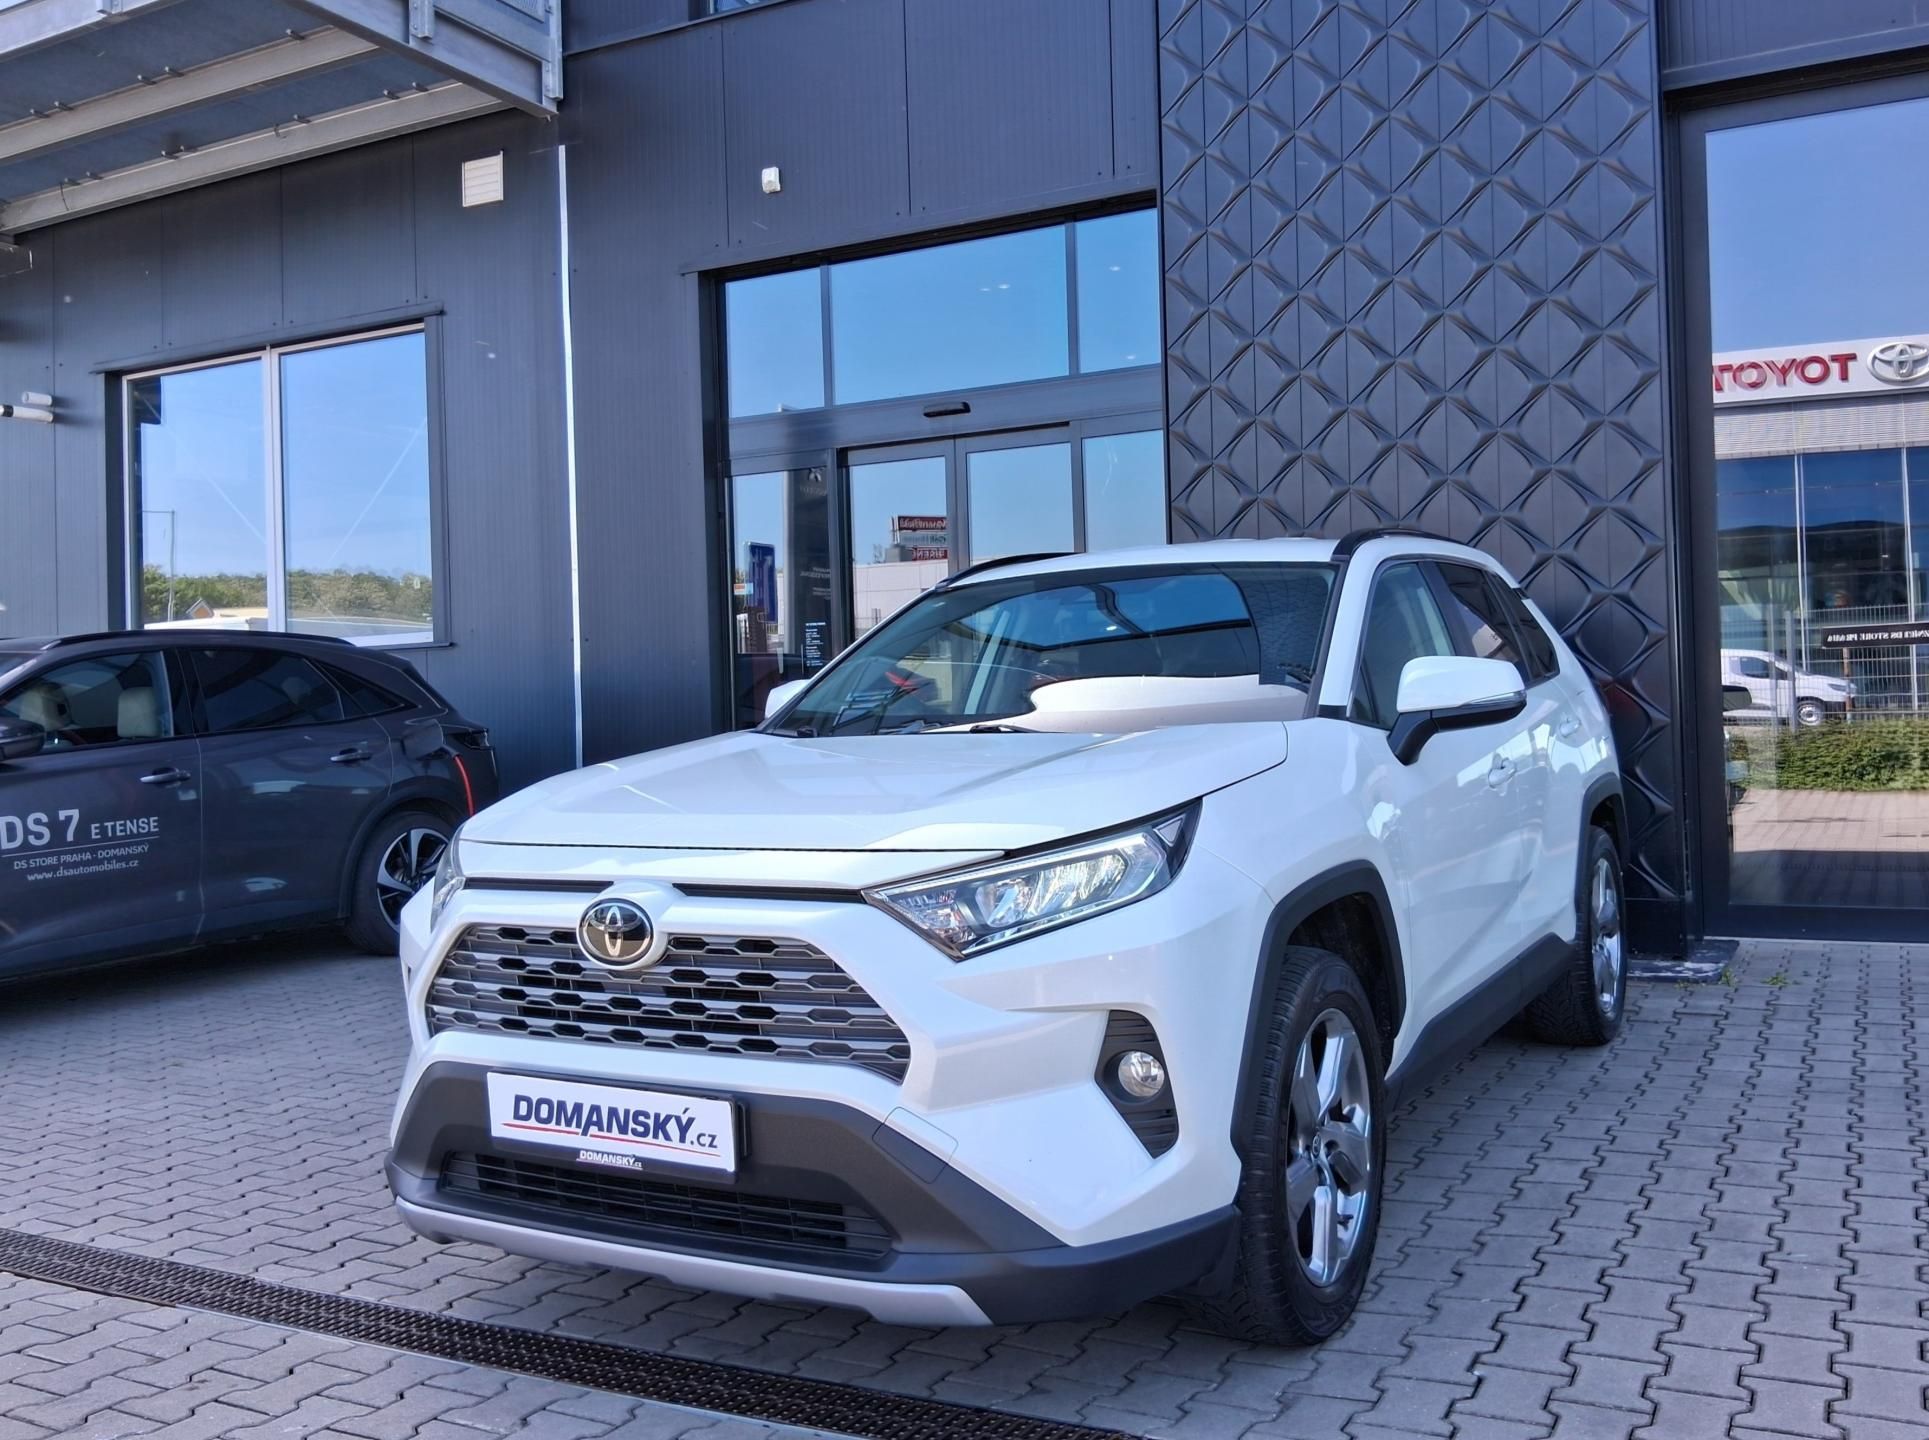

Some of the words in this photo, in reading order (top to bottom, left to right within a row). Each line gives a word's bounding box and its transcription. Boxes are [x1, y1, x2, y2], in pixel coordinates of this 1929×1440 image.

[0, 812, 51, 850] DS
[58, 809, 80, 842] 7
[91, 823, 101, 839] E
[104, 816, 160, 838] TENSE
[14, 860, 28, 870] DS
[29, 856, 59, 868] STORE
[60, 851, 92, 864] PRAHA
[27, 859, 140, 881] www.dsautomobiles.cz
